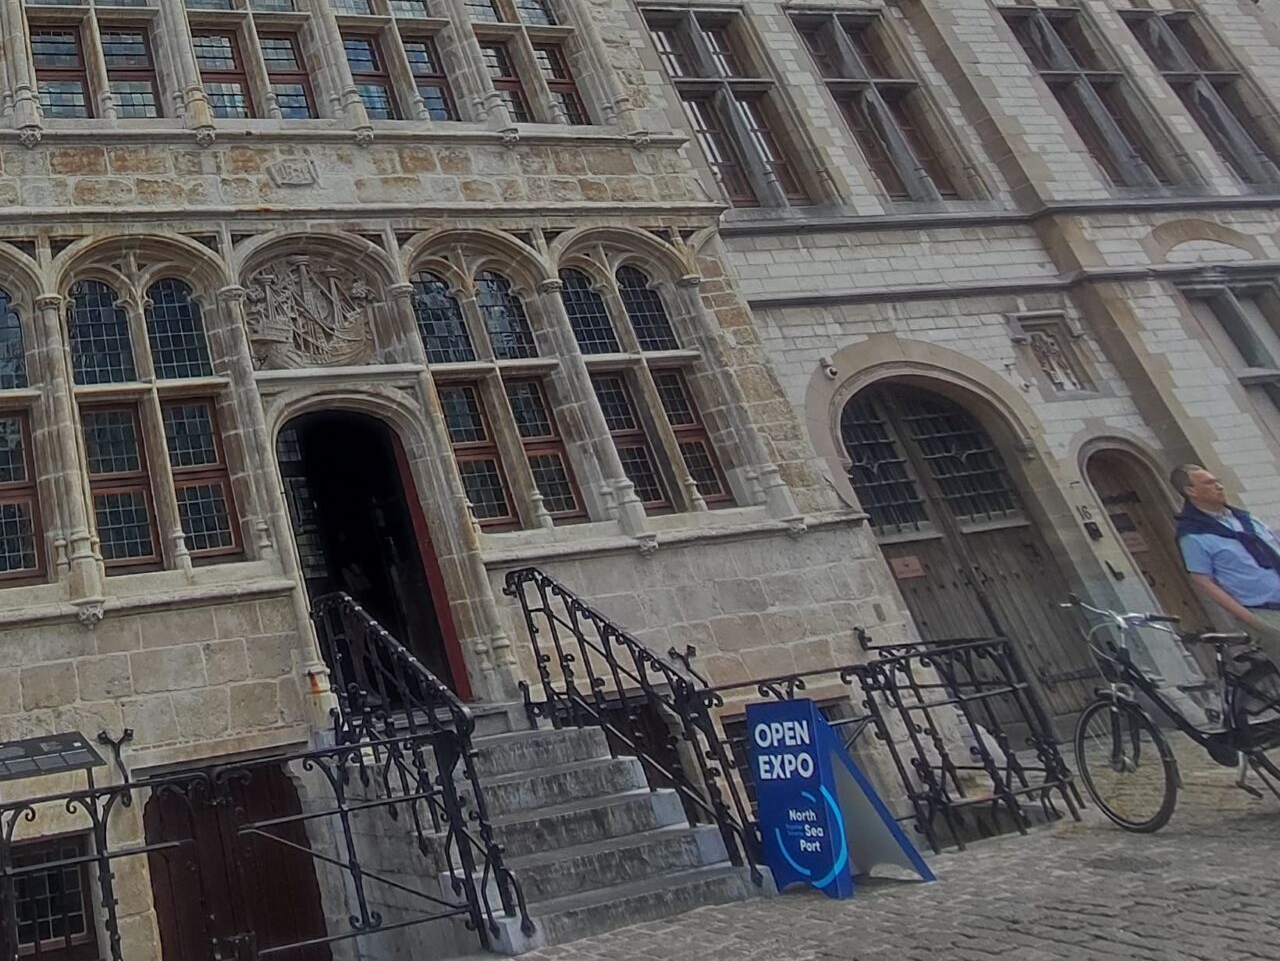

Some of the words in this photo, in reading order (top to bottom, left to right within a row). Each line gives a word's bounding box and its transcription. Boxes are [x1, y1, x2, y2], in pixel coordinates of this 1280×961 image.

[1075, 505, 1093, 520] 16
[754, 720, 810, 748] OPEN
[758, 752, 814, 780] EXPO
[788, 809, 817, 822] North
[804, 824, 824, 837] Sea
[800, 839, 822, 852] Port
